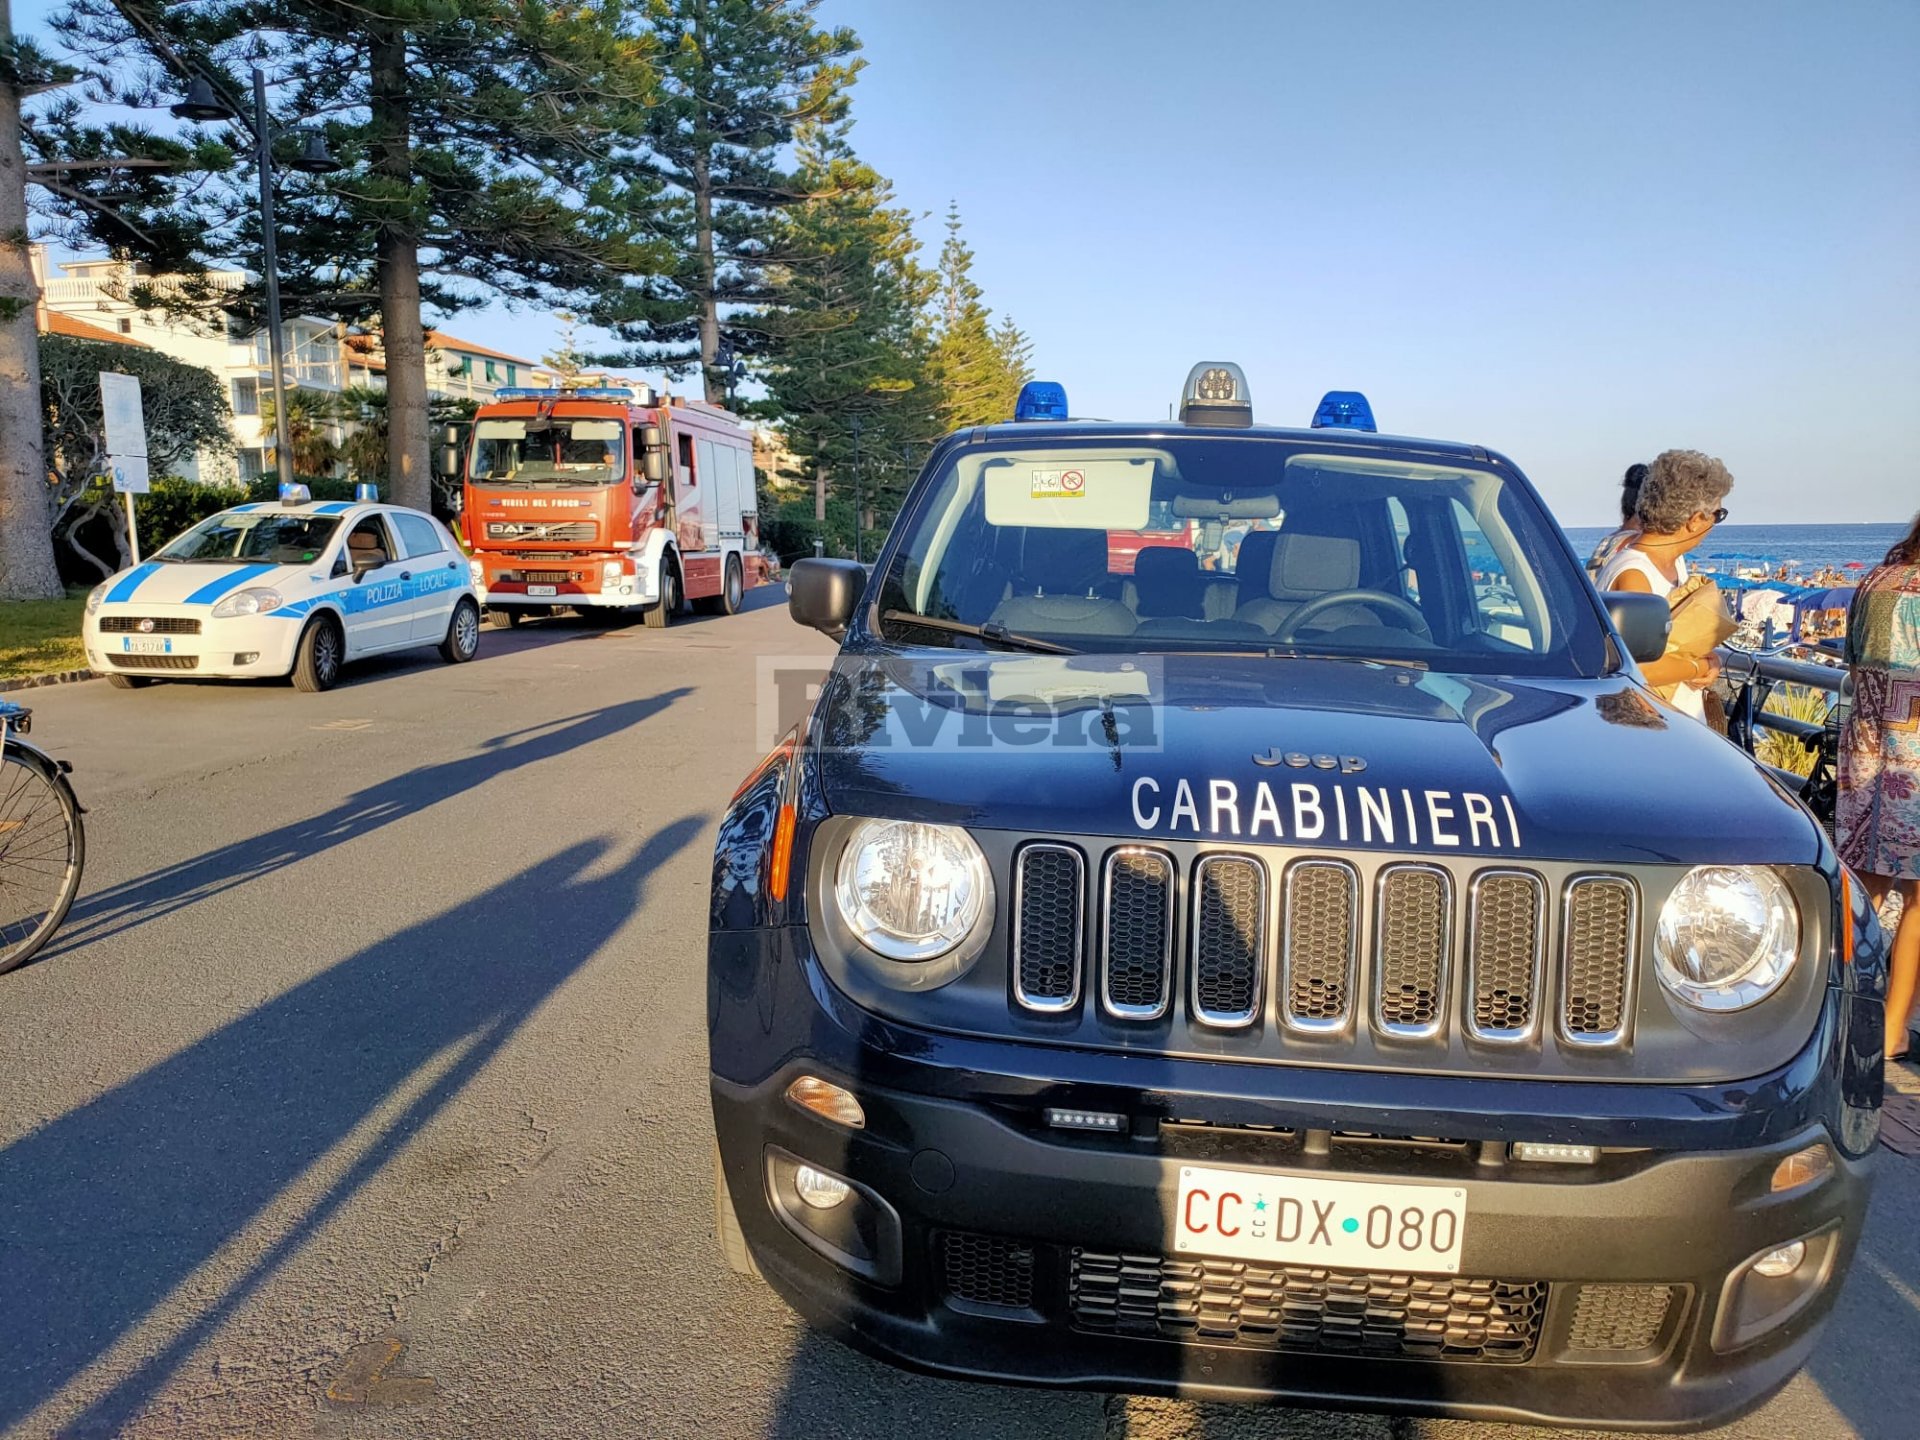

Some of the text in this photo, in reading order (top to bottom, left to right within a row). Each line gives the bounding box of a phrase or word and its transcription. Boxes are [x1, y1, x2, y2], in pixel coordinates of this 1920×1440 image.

[501, 499, 579, 508] VIGILI DEL FUOCO
[490, 524, 524, 533] BAI
[366, 571, 449, 605] POLIZIA LOCALE
[1252, 747, 1368, 774] Jeep
[1131, 776, 1521, 848] CARABINIERI
